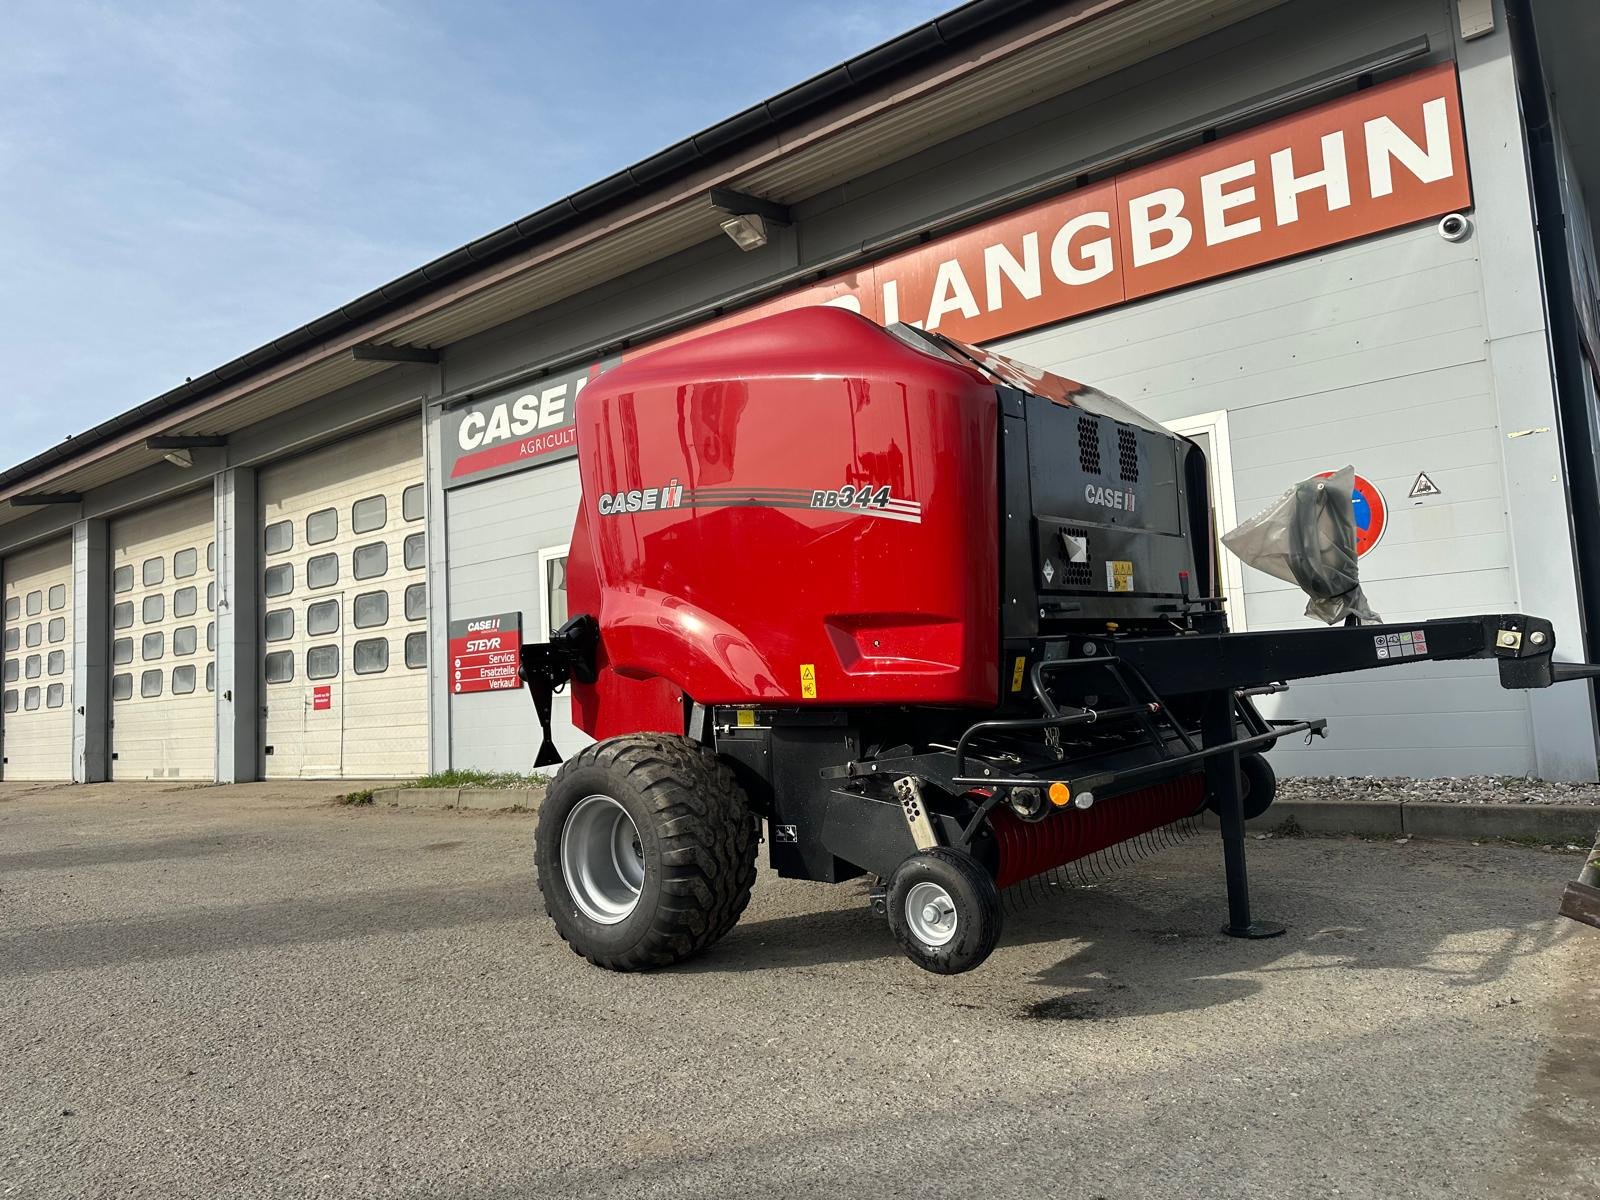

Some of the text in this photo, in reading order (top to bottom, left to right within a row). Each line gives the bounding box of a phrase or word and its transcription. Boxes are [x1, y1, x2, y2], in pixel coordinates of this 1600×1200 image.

[458, 384, 568, 451] CASE
[520, 429, 576, 456] AGRICULT
[599, 488, 658, 515] CASE
[1085, 484, 1122, 509] CASE
[468, 620, 491, 632] CASE
[466, 637, 501, 652] STEYR
[489, 653, 515, 664] Service
[480, 665, 515, 677] Ersatzteile
[489, 677, 515, 688] Verkauf
